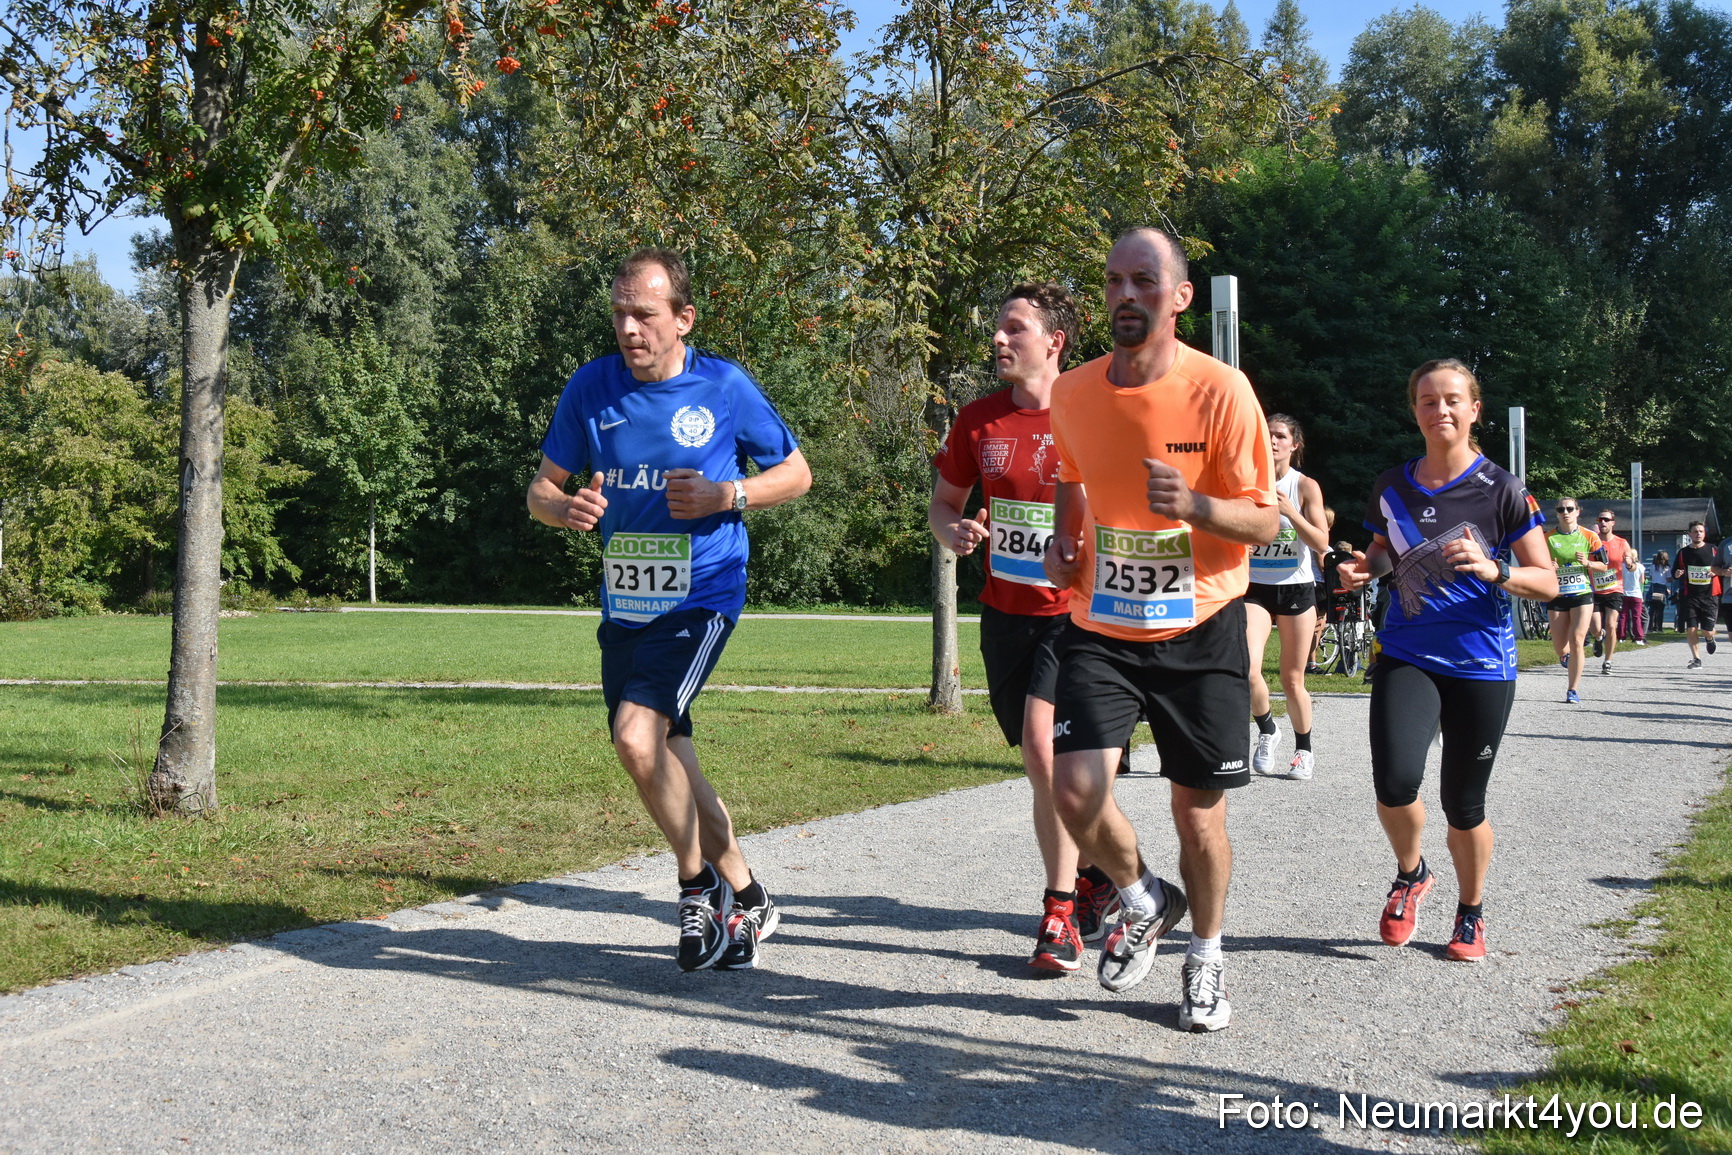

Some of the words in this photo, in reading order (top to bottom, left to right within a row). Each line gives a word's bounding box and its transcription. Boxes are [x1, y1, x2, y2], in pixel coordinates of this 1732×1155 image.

[983, 443, 1009, 451] IMMER
[1165, 442, 1207, 453] THULE
[982, 456, 1006, 467] NEU
[982, 466, 1005, 474] MARKT
[1475, 471, 1495, 486] Nessa
[609, 537, 681, 557] BOCK
[1101, 531, 1184, 555] BOCK
[1183, 565, 1190, 573] C
[612, 564, 678, 591] 2312
[1104, 560, 1181, 595] 2532
[1557, 574, 1582, 586] 2506
[1595, 575, 1614, 584] 1149
[1113, 601, 1168, 617] MARCO
[1220, 759, 1243, 770] JAKO
